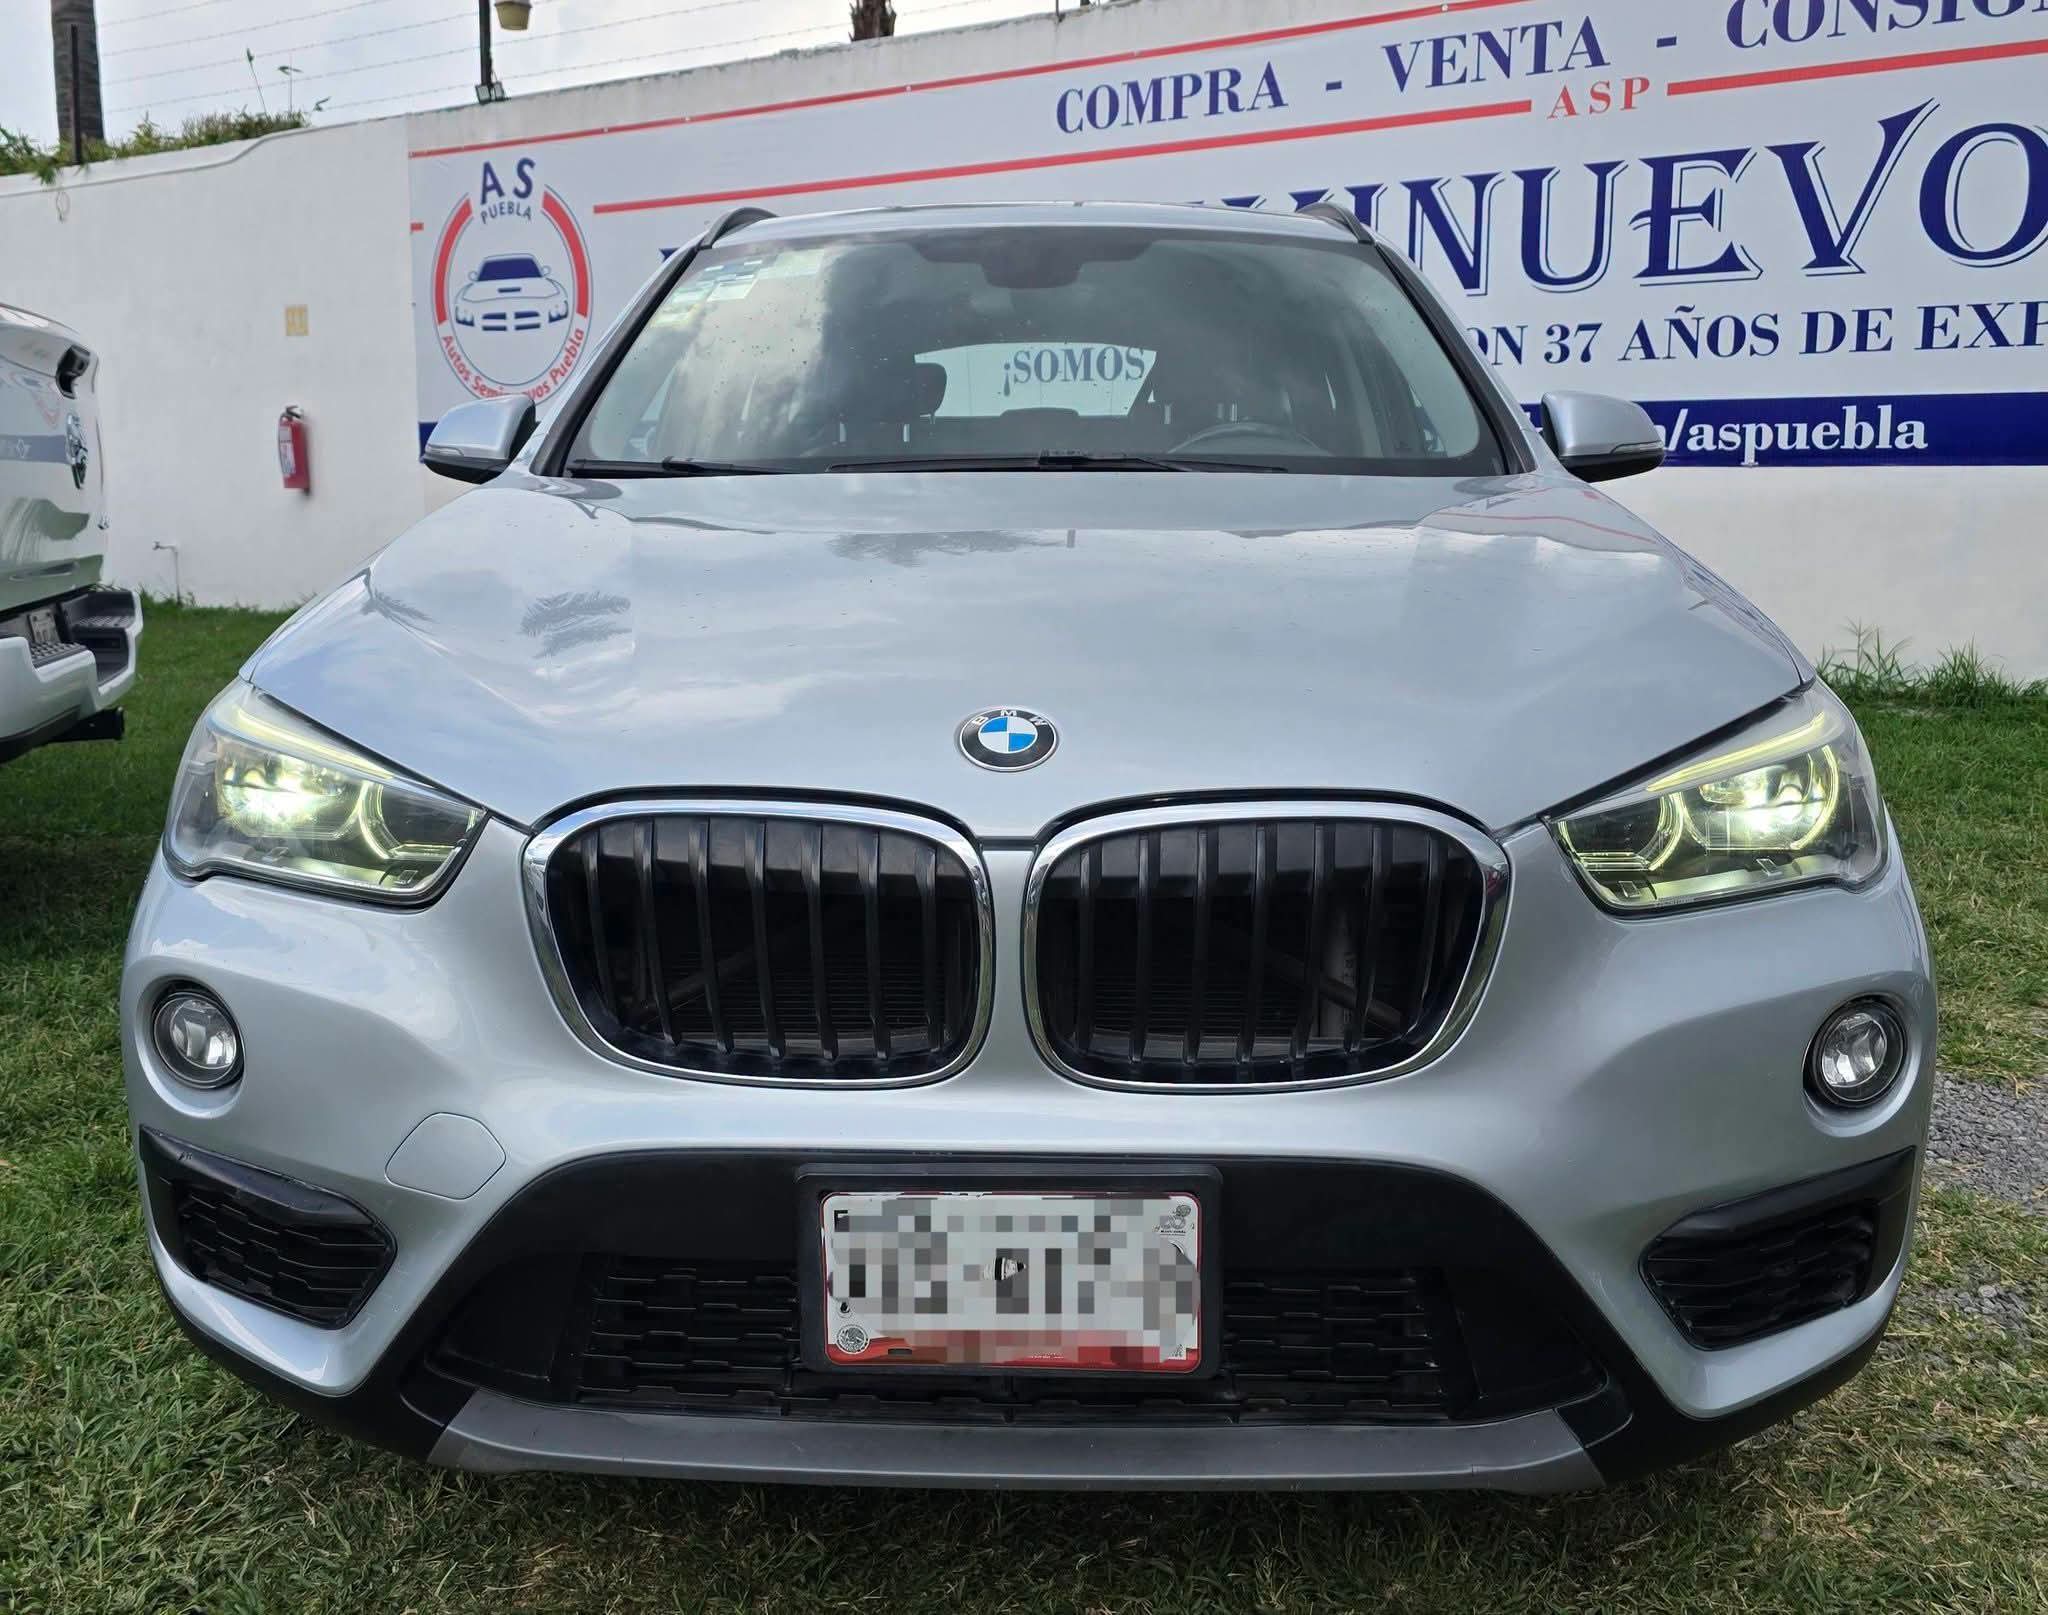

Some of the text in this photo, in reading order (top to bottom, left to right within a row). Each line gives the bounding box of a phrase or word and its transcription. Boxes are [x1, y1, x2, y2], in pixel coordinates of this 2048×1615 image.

[1056, 61, 1289, 134] COMPRA
[1381, 15, 1611, 94] VENTA
[1547, 76, 1650, 120] ASP
[480, 201, 532, 224] PUEBLA
[442, 335, 472, 381] Autos
[550, 328, 585, 385] Puebla
[1003, 346, 1145, 397] ¡SOMOS
[1543, 322, 1602, 364] 37
[1617, 304, 1779, 362] AÑOS
[1799, 308, 1893, 354] DE
[1654, 404, 1928, 466] /aspuebla
[971, 709, 1048, 726] BMW
